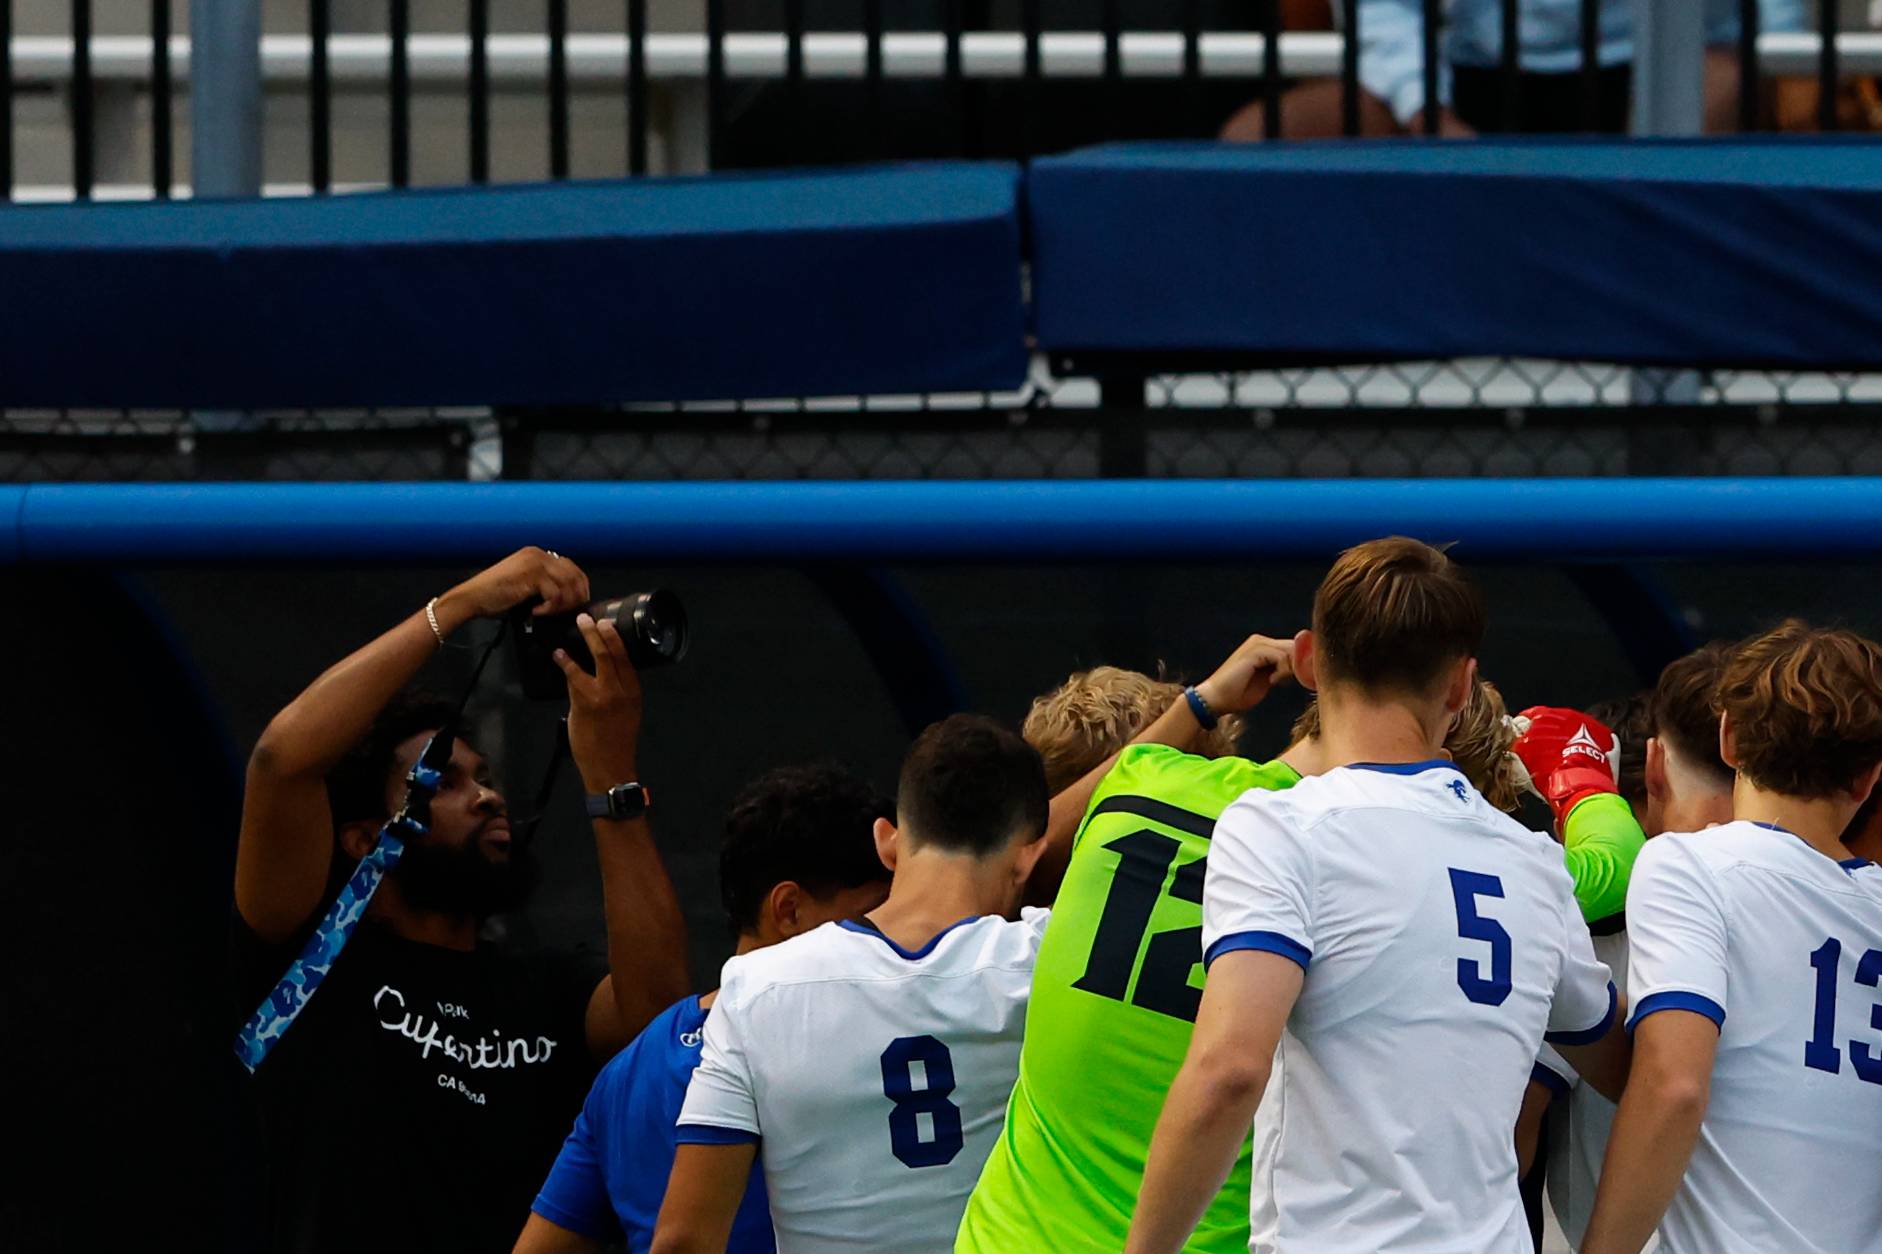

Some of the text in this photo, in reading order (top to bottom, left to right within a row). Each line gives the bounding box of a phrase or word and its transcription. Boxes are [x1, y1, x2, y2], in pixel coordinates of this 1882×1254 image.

[1562, 745, 1605, 763] SELECT
[1448, 867, 1512, 1007] 5
[374, 985, 557, 1069] Cupertino
[880, 1035, 964, 1168] 8
